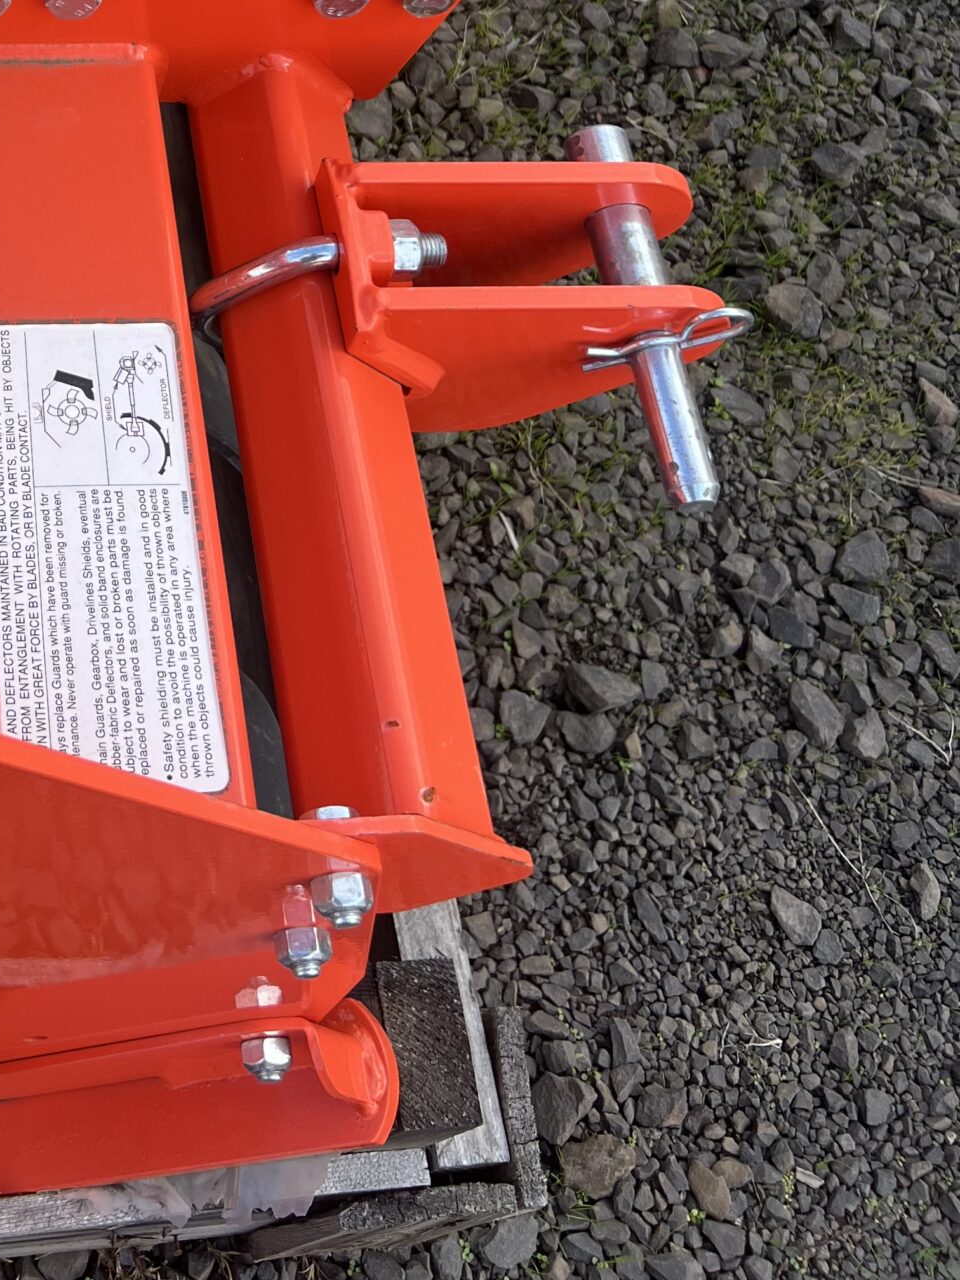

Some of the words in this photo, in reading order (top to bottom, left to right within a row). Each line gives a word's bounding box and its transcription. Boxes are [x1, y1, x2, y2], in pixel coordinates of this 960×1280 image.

[0, 329, 12, 373] OBJECTS
[2, 377, 12, 391] BY
[159, 378, 170, 419] DEFLECTOR
[3, 396, 13, 412] HIT
[103, 396, 112, 421] SHIELD
[3, 417, 16, 450] BEING
[16, 409, 30, 463] CONTACT.
[6, 455, 19, 495] PARTS,
[19, 465, 32, 501] BLADE
[21, 503, 33, 518] BY
[38, 492, 49, 506] for
[51, 489, 63, 526] broken.
[75, 490, 89, 534] eventual
[90, 488, 99, 505] are
[101, 488, 112, 503] be
[112, 487, 126, 522] found.
[135, 488, 150, 518] good
[147, 487, 162, 527] objects
[159, 487, 172, 522] where
[8, 500, 22, 558] ROTATING
[22, 521, 34, 538] OR
[39, 508, 52, 553] removed
[55, 528, 64, 539] or
[90, 507, 104, 562] enclosures
[103, 506, 115, 535] must
[118, 524, 127, 534] is
[139, 521, 149, 532] in
[106, 538, 119, 568] parts
[140, 535, 152, 558] and
[152, 530, 165, 569] thrown
[164, 525, 175, 551] area
[24, 541, 38, 589] BLADES,
[42, 556, 54, 583] been
[56, 541, 69, 578] missing
[79, 536, 94, 579] Shields,
[118, 537, 134, 585] damage
[168, 554, 179, 576] any
[12, 564, 24, 595] WITH
[94, 565, 107, 591] band
[108, 571, 122, 613] broken
[143, 561, 157, 612] installed
[156, 572, 167, 584] of
[170, 579, 179, 590] in
[181, 564, 195, 601] injury.
[27, 592, 38, 608] BY
[45, 585, 56, 611] have
[57, 581, 71, 610] guard
[83, 581, 97, 635] Drivelines
[97, 594, 109, 619] solid
[124, 588, 133, 602] as
[28, 611, 41, 653] FORCE
[46, 614, 59, 646] which
[60, 612, 71, 633] with
[99, 621, 111, 642] and
[114, 616, 123, 629] or
[125, 605, 136, 635] soon
[148, 615, 159, 631] be
[158, 587, 175, 645] possibility
[170, 593, 188, 647] operated
[185, 604, 198, 642] cause
[13, 600, 30, 699] ENTANGLEMENT
[61, 635, 76, 676] operate
[113, 632, 126, 655] lost
[128, 638, 138, 653] as
[151, 635, 163, 666] must
[164, 648, 176, 668] the
[177, 650, 188, 660] is
[1, 624, 16, 705] DEFLECTORS
[30, 655, 44, 698] GREAT
[48, 648, 62, 690] Guards
[87, 638, 103, 690] Gearbox,
[101, 645, 117, 704] Deflectors,
[116, 658, 128, 682] and
[188, 645, 202, 680] could
[64, 678, 77, 709] Never
[128, 656, 146, 707] repaired
[167, 670, 181, 704] avoid
[179, 664, 195, 717] machine
[52, 692, 67, 733] replace
[120, 685, 131, 717] wear
[154, 670, 172, 727] shielding
[172, 707, 182, 720] to
[194, 683, 211, 730] objects
[5, 708, 17, 735] AND
[16, 705, 33, 742] FROM
[33, 700, 47, 732] WITH
[91, 693, 106, 738] Guards,
[121, 719, 133, 732] to
[135, 710, 145, 724] or
[185, 720, 197, 741] the
[122, 734, 139, 774] ubject
[135, 726, 152, 775] eplaced
[159, 731, 177, 772] Safety
[173, 722, 189, 779] condition
[188, 744, 202, 778] when
[200, 733, 215, 778] thrown
